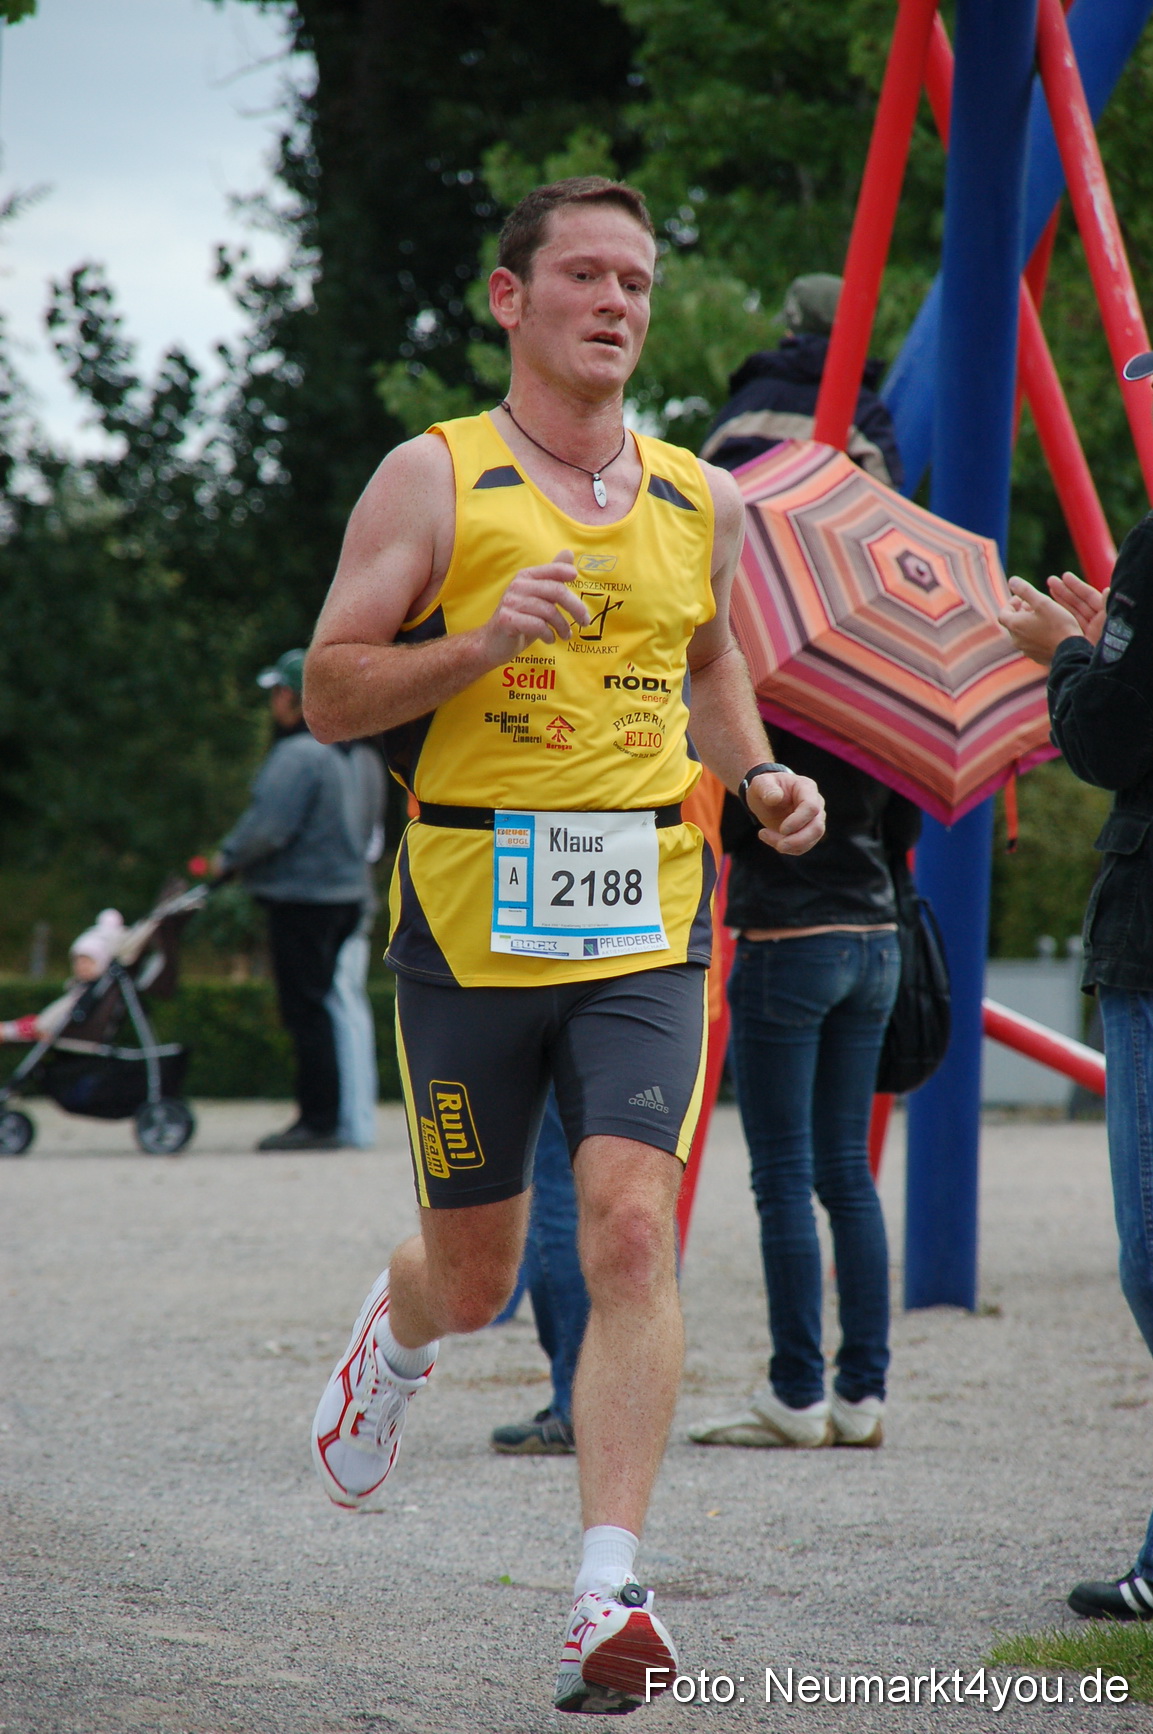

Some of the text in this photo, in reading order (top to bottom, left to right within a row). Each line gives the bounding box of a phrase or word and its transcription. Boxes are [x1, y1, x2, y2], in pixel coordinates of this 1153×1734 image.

[565, 580, 632, 592] ONDSZENTRUM
[502, 666, 556, 690] Seidl
[508, 689, 547, 702] Berngau
[624, 730, 662, 749] ELIO
[549, 827, 604, 853] Klaus
[509, 866, 519, 885] A
[550, 868, 643, 907] 2188
[599, 933, 664, 949] PFLEIDERER
[628, 1096, 670, 1114] adidas
[436, 1092, 476, 1159] Run!
